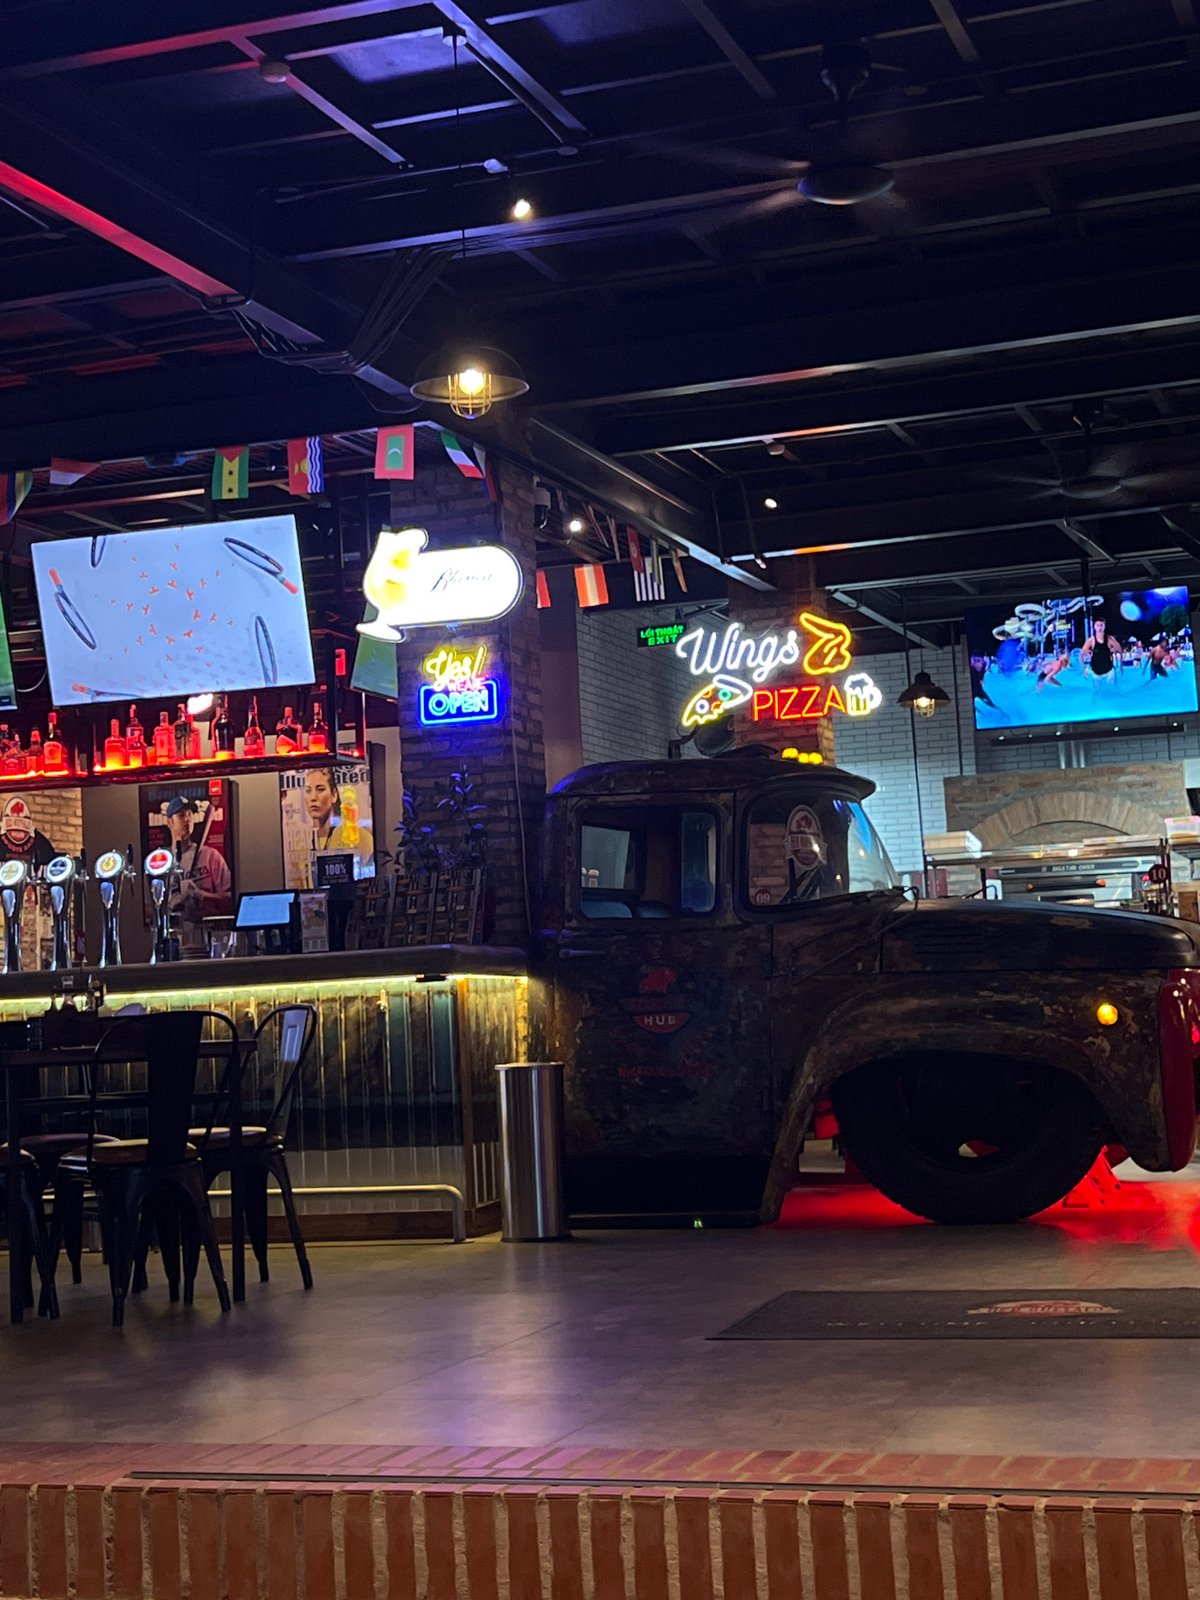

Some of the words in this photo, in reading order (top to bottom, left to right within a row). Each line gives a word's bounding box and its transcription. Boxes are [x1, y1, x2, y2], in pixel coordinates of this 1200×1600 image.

[648, 634, 678, 646] EXIT
[675, 622, 800, 683] Wings
[428, 689, 489, 717] OPEN
[752, 684, 847, 722] PIZZA
[325, 863, 347, 876] 100%
[1151, 869, 1167, 881] 10
[756, 894, 770, 904] 09
[644, 1015, 676, 1026] HUB
